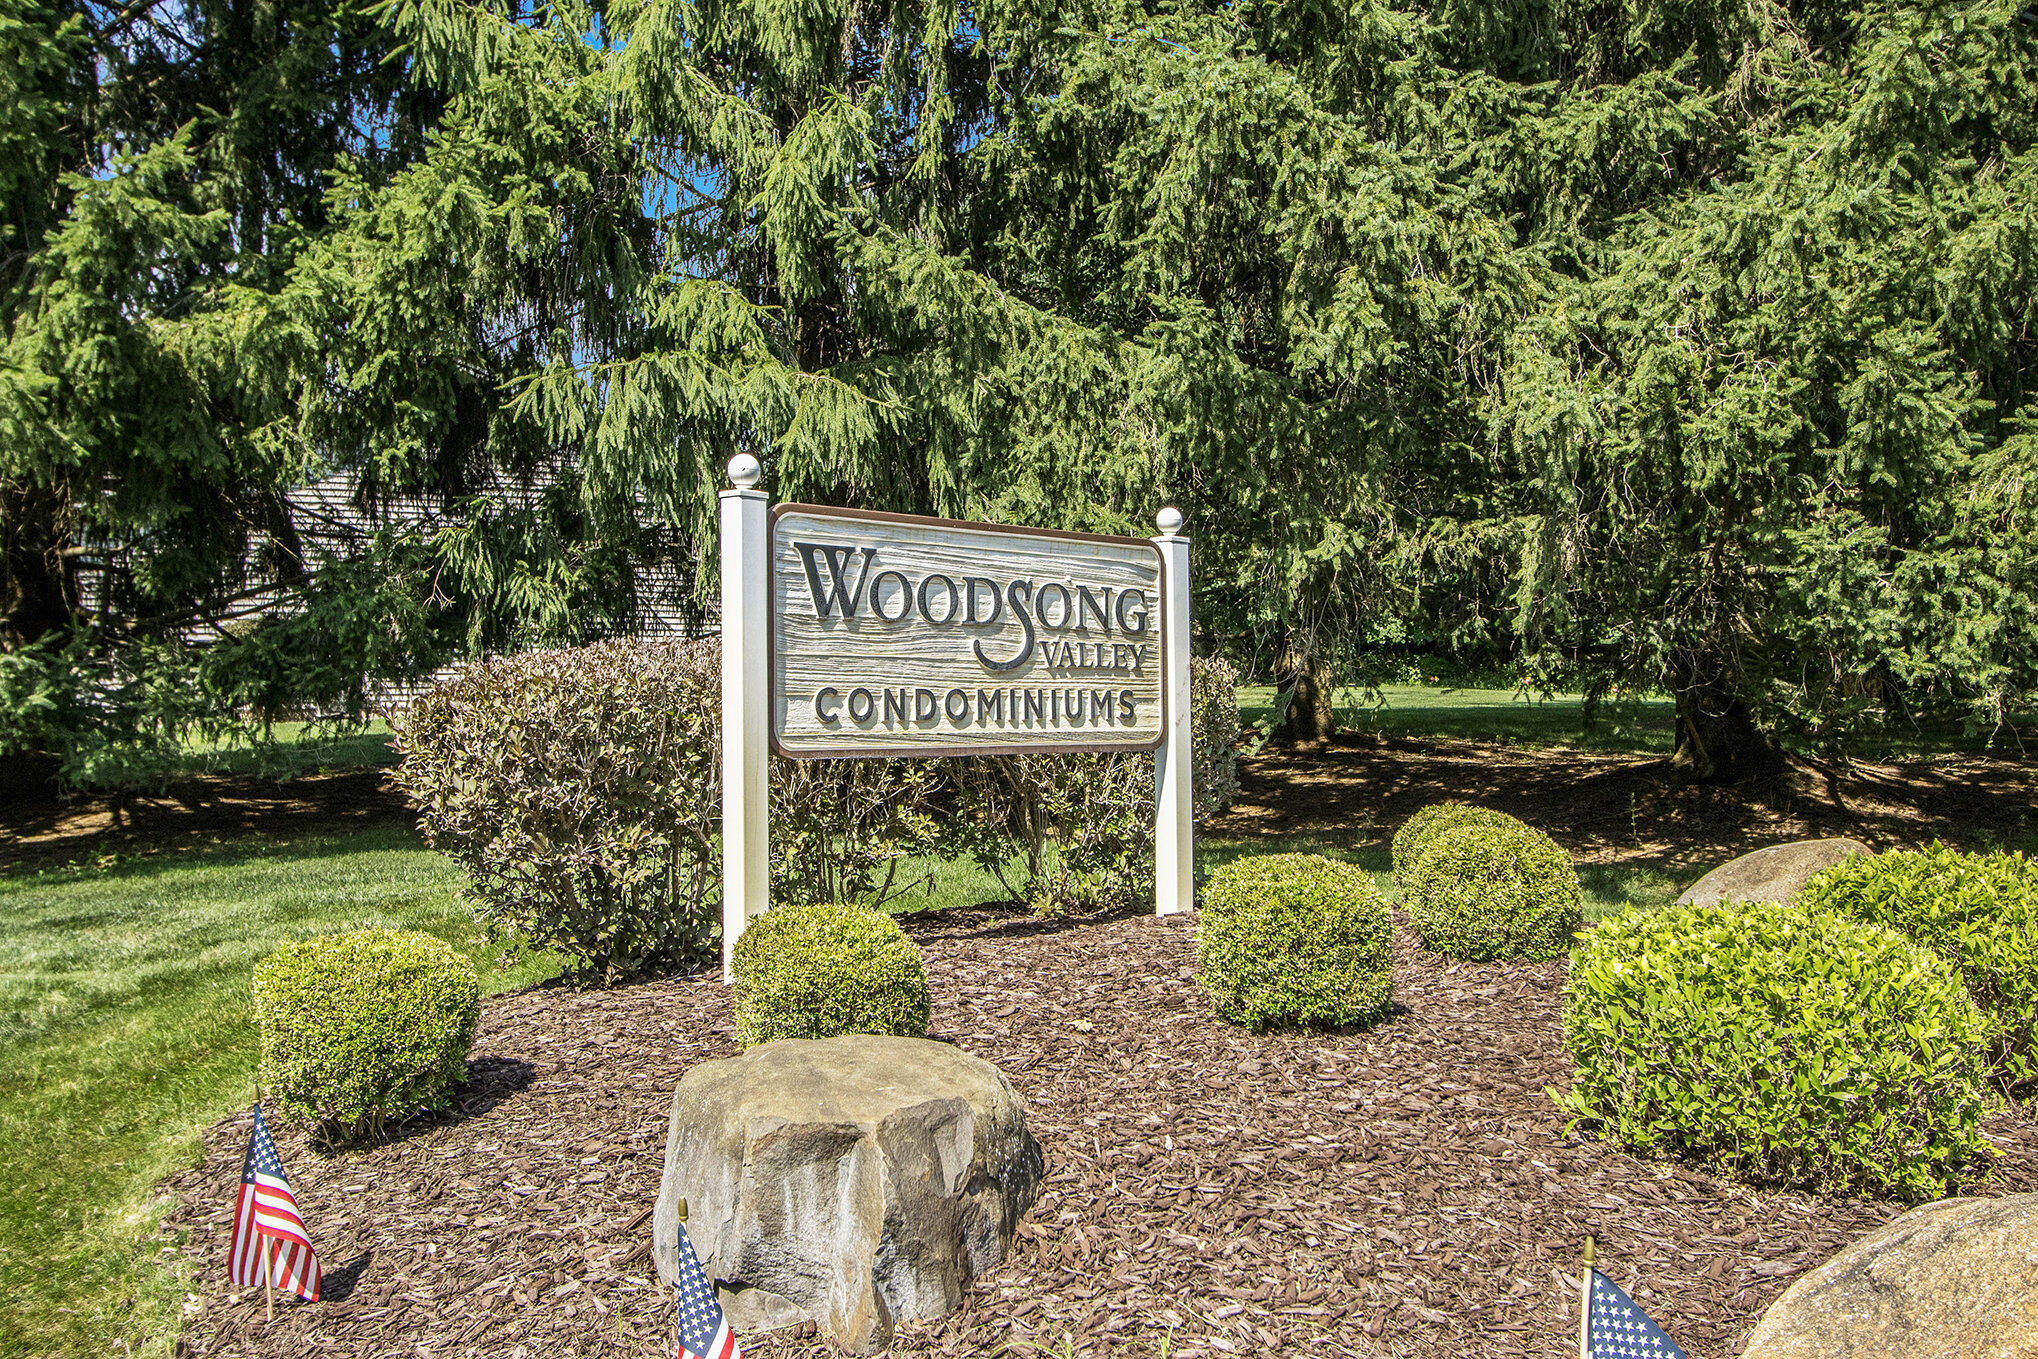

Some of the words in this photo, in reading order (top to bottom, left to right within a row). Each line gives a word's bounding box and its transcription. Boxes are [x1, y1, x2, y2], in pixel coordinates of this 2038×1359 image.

[793, 542, 1148, 671] WOODSONG
[1040, 640, 1146, 670] VALLEY
[815, 687, 1135, 723] CONDOMINIUMS
